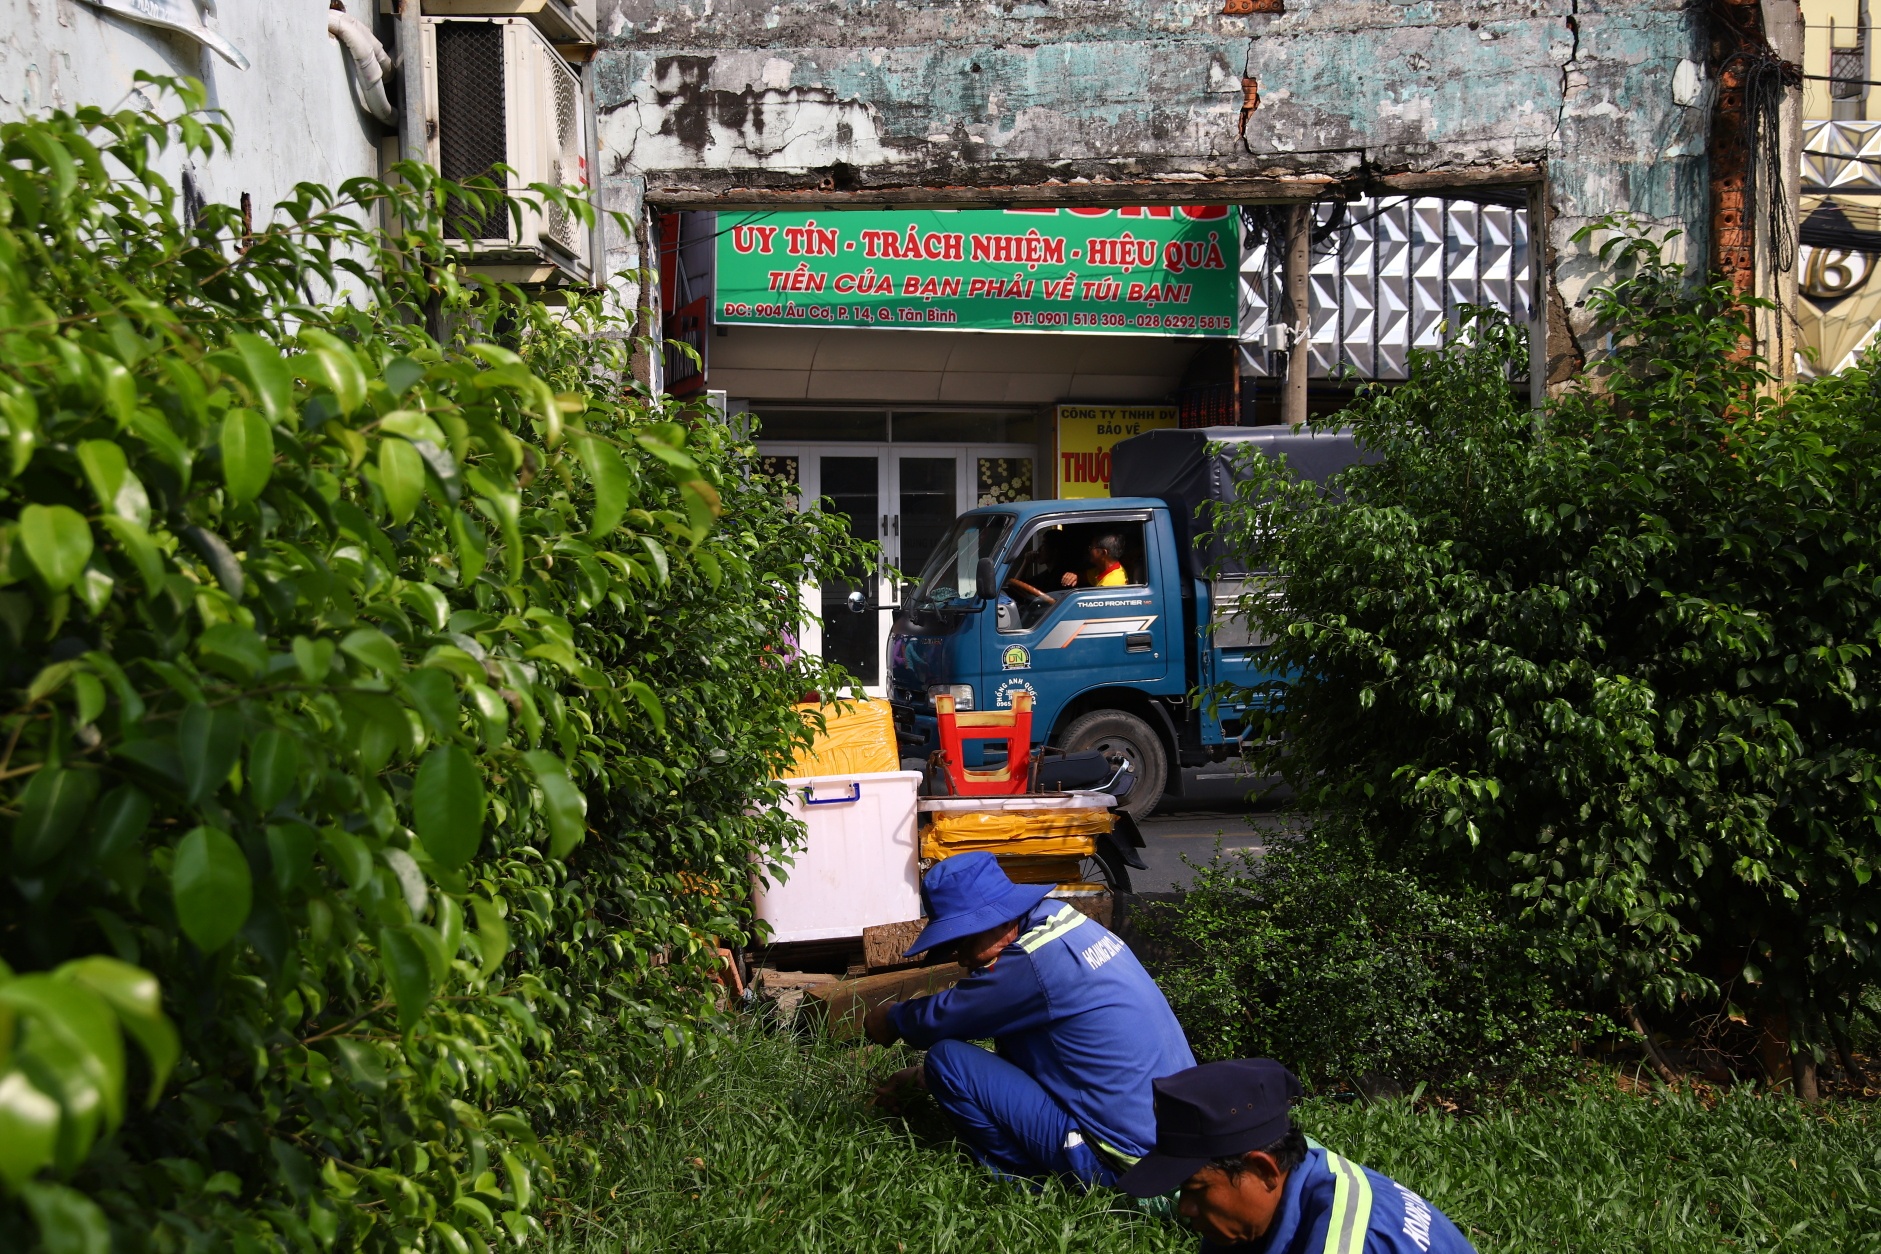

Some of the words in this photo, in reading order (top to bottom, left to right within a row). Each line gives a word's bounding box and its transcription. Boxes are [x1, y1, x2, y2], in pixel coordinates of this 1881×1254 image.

[732, 224, 778, 255] UY
[784, 220, 839, 257] TÍN
[861, 224, 964, 261] TRÁCH
[970, 228, 1065, 271] NHIỆM
[1086, 231, 1157, 274] HIỆU
[1163, 231, 1226, 274] QUẢ
[768, 261, 827, 293] TIỀN
[833, 268, 894, 295] CỦA
[902, 276, 962, 302] BẠN
[967, 273, 1035, 299] PHẢI
[1043, 271, 1078, 300] VỀ
[1082, 276, 1121, 302] TÚI
[1127, 282, 1193, 307] BẠN!
[724, 304, 752, 317] ĐC:
[755, 304, 782, 318] 904
[785, 301, 804, 319] Âu
[808, 305, 834, 322] Cơ,
[837, 307, 849, 320] P.
[854, 307, 874, 323] 14,
[878, 307, 894, 322] Q.
[898, 306, 923, 322] Tân
[926, 307, 957, 323] Bình
[1013, 311, 1034, 325] ĐT:
[1037, 312, 1068, 326] 0901
[1073, 313, 1097, 327] 518
[1101, 313, 1126, 327] 308
[1136, 315, 1161, 328] 028
[1164, 315, 1195, 329] 6292
[1199, 315, 1231, 330] 5815
[1061, 407, 1096, 419] CÔNG
[1100, 410, 1116, 419] TY
[1120, 410, 1155, 419] TNHH
[1159, 410, 1177, 420] DV
[1097, 421, 1122, 435] BẢO
[1061, 446, 1113, 489] THƯỢ
